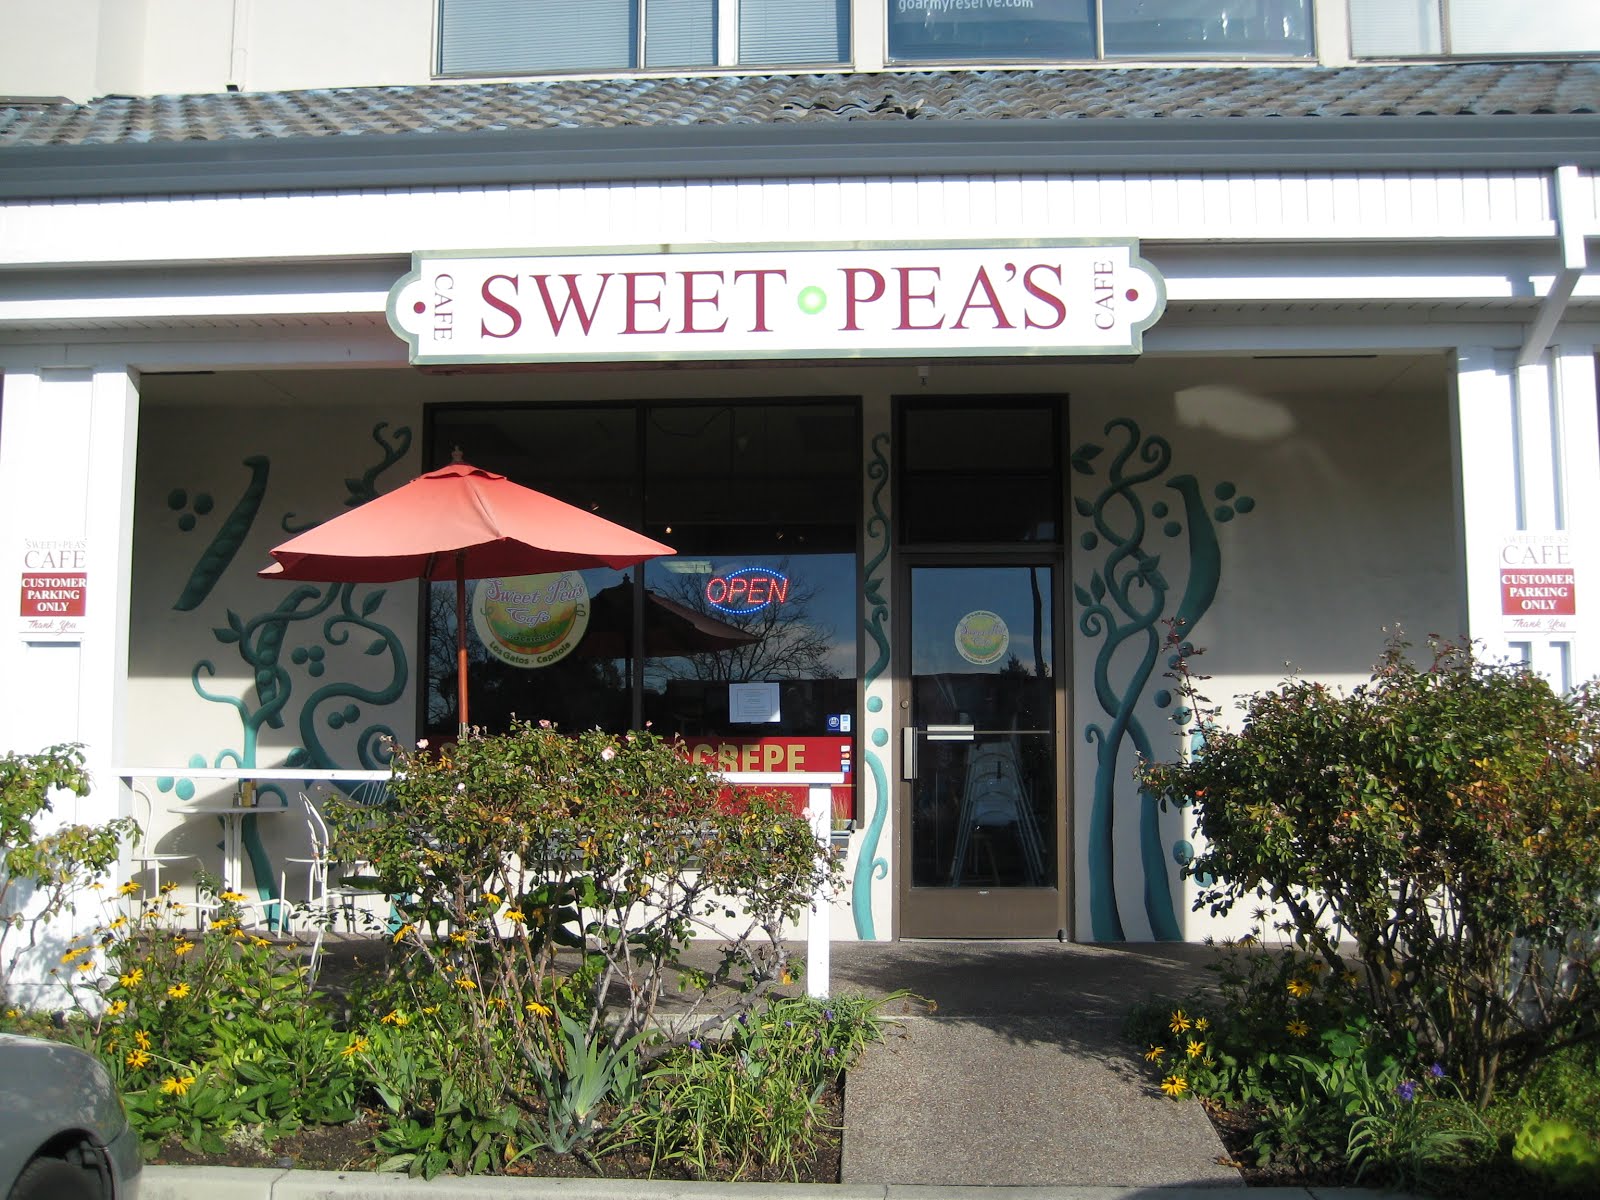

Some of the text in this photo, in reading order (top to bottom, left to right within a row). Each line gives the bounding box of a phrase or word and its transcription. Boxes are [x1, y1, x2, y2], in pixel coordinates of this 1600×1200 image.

[898, 0, 1034, 13] goarmyreserve.com
[480, 262, 1067, 339] SWEET PEA'S
[1093, 260, 1115, 331] CAFE
[433, 273, 455, 342] CAFE
[24, 549, 87, 569] CAFE
[1502, 544, 1571, 565] CAFE
[22, 577, 87, 588] CUSTOMER
[1501, 574, 1575, 585] CUSTOMER
[27, 590, 80, 600] PARKING
[486, 578, 541, 605] Sweet
[706, 577, 788, 604] OPEN
[1509, 587, 1568, 597] PARKING
[37, 601, 69, 612] ONLY
[1521, 599, 1557, 610] ONLY
[27, 619, 77, 636] Thank You
[1512, 618, 1567, 636] Thank You
[489, 641, 571, 665] Los Gatos Capitola
